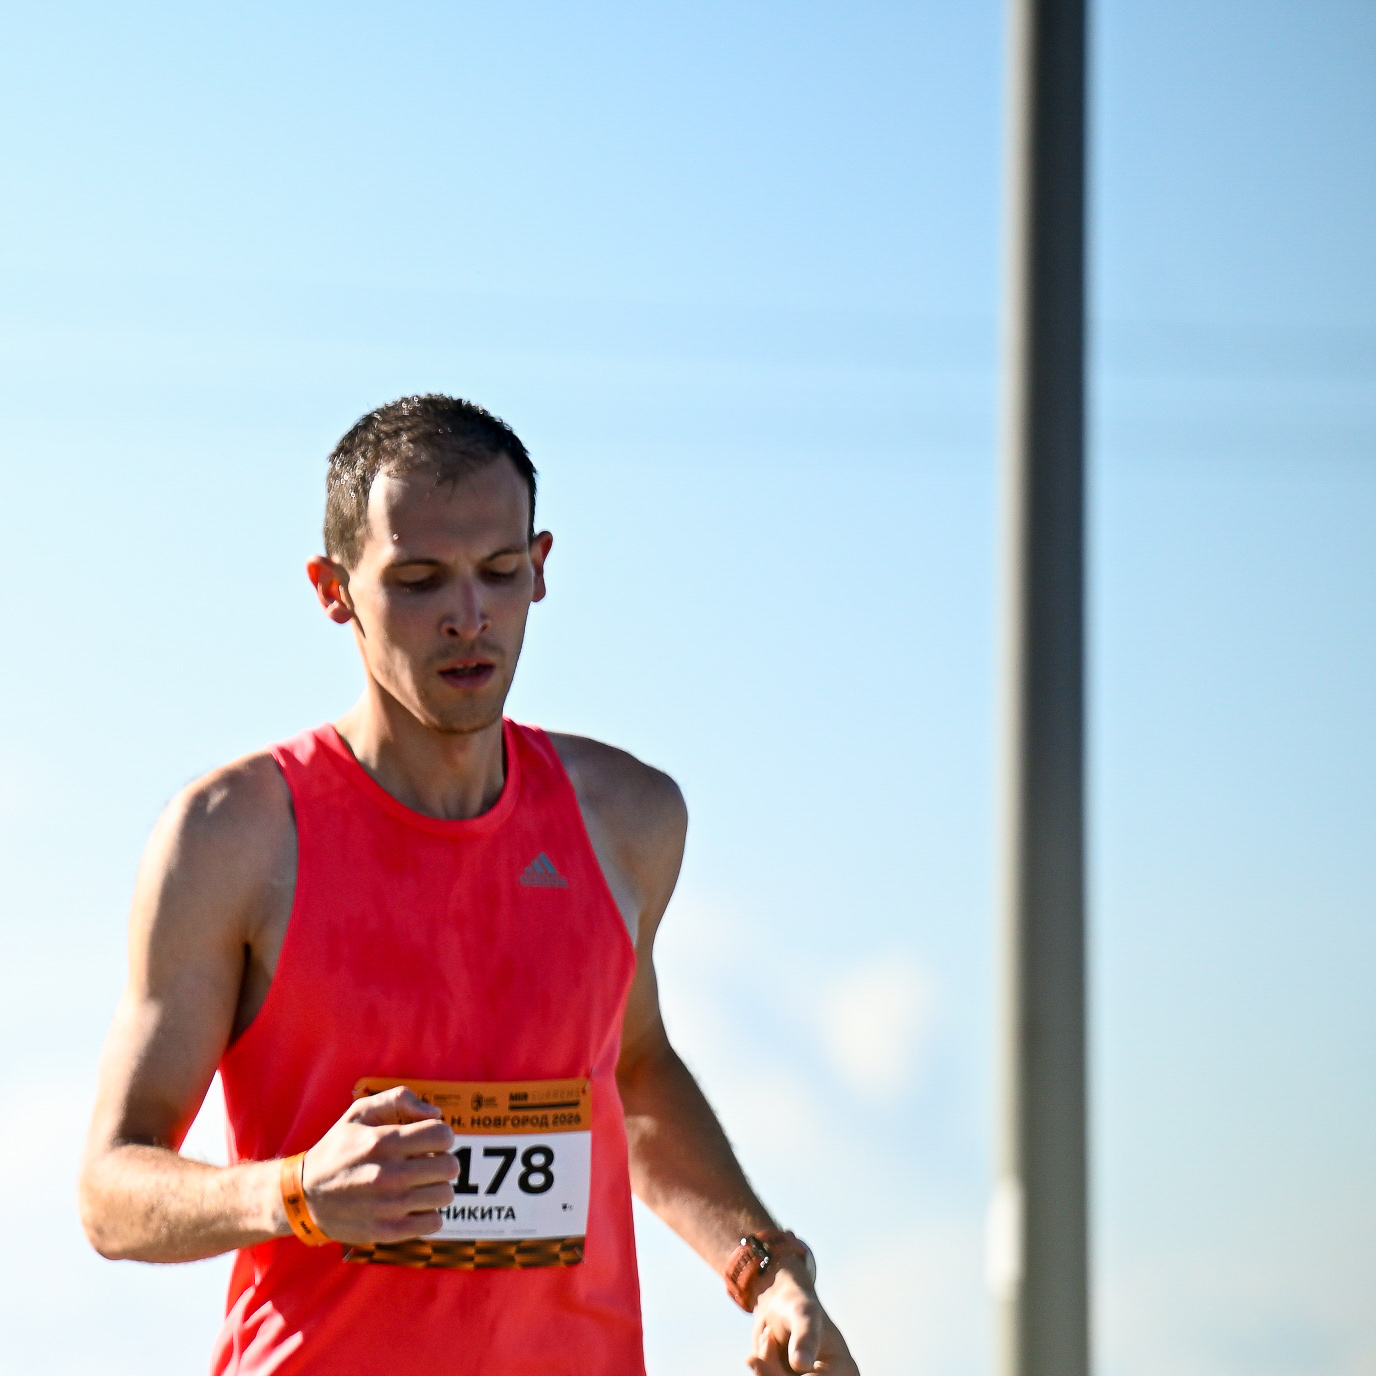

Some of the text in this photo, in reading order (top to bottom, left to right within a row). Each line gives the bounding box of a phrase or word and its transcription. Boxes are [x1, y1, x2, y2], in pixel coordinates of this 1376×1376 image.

[471, 1113, 550, 1129] НОВГОРОД
[453, 1144, 555, 1195] 178
[438, 1205, 517, 1221] НИКИТА
